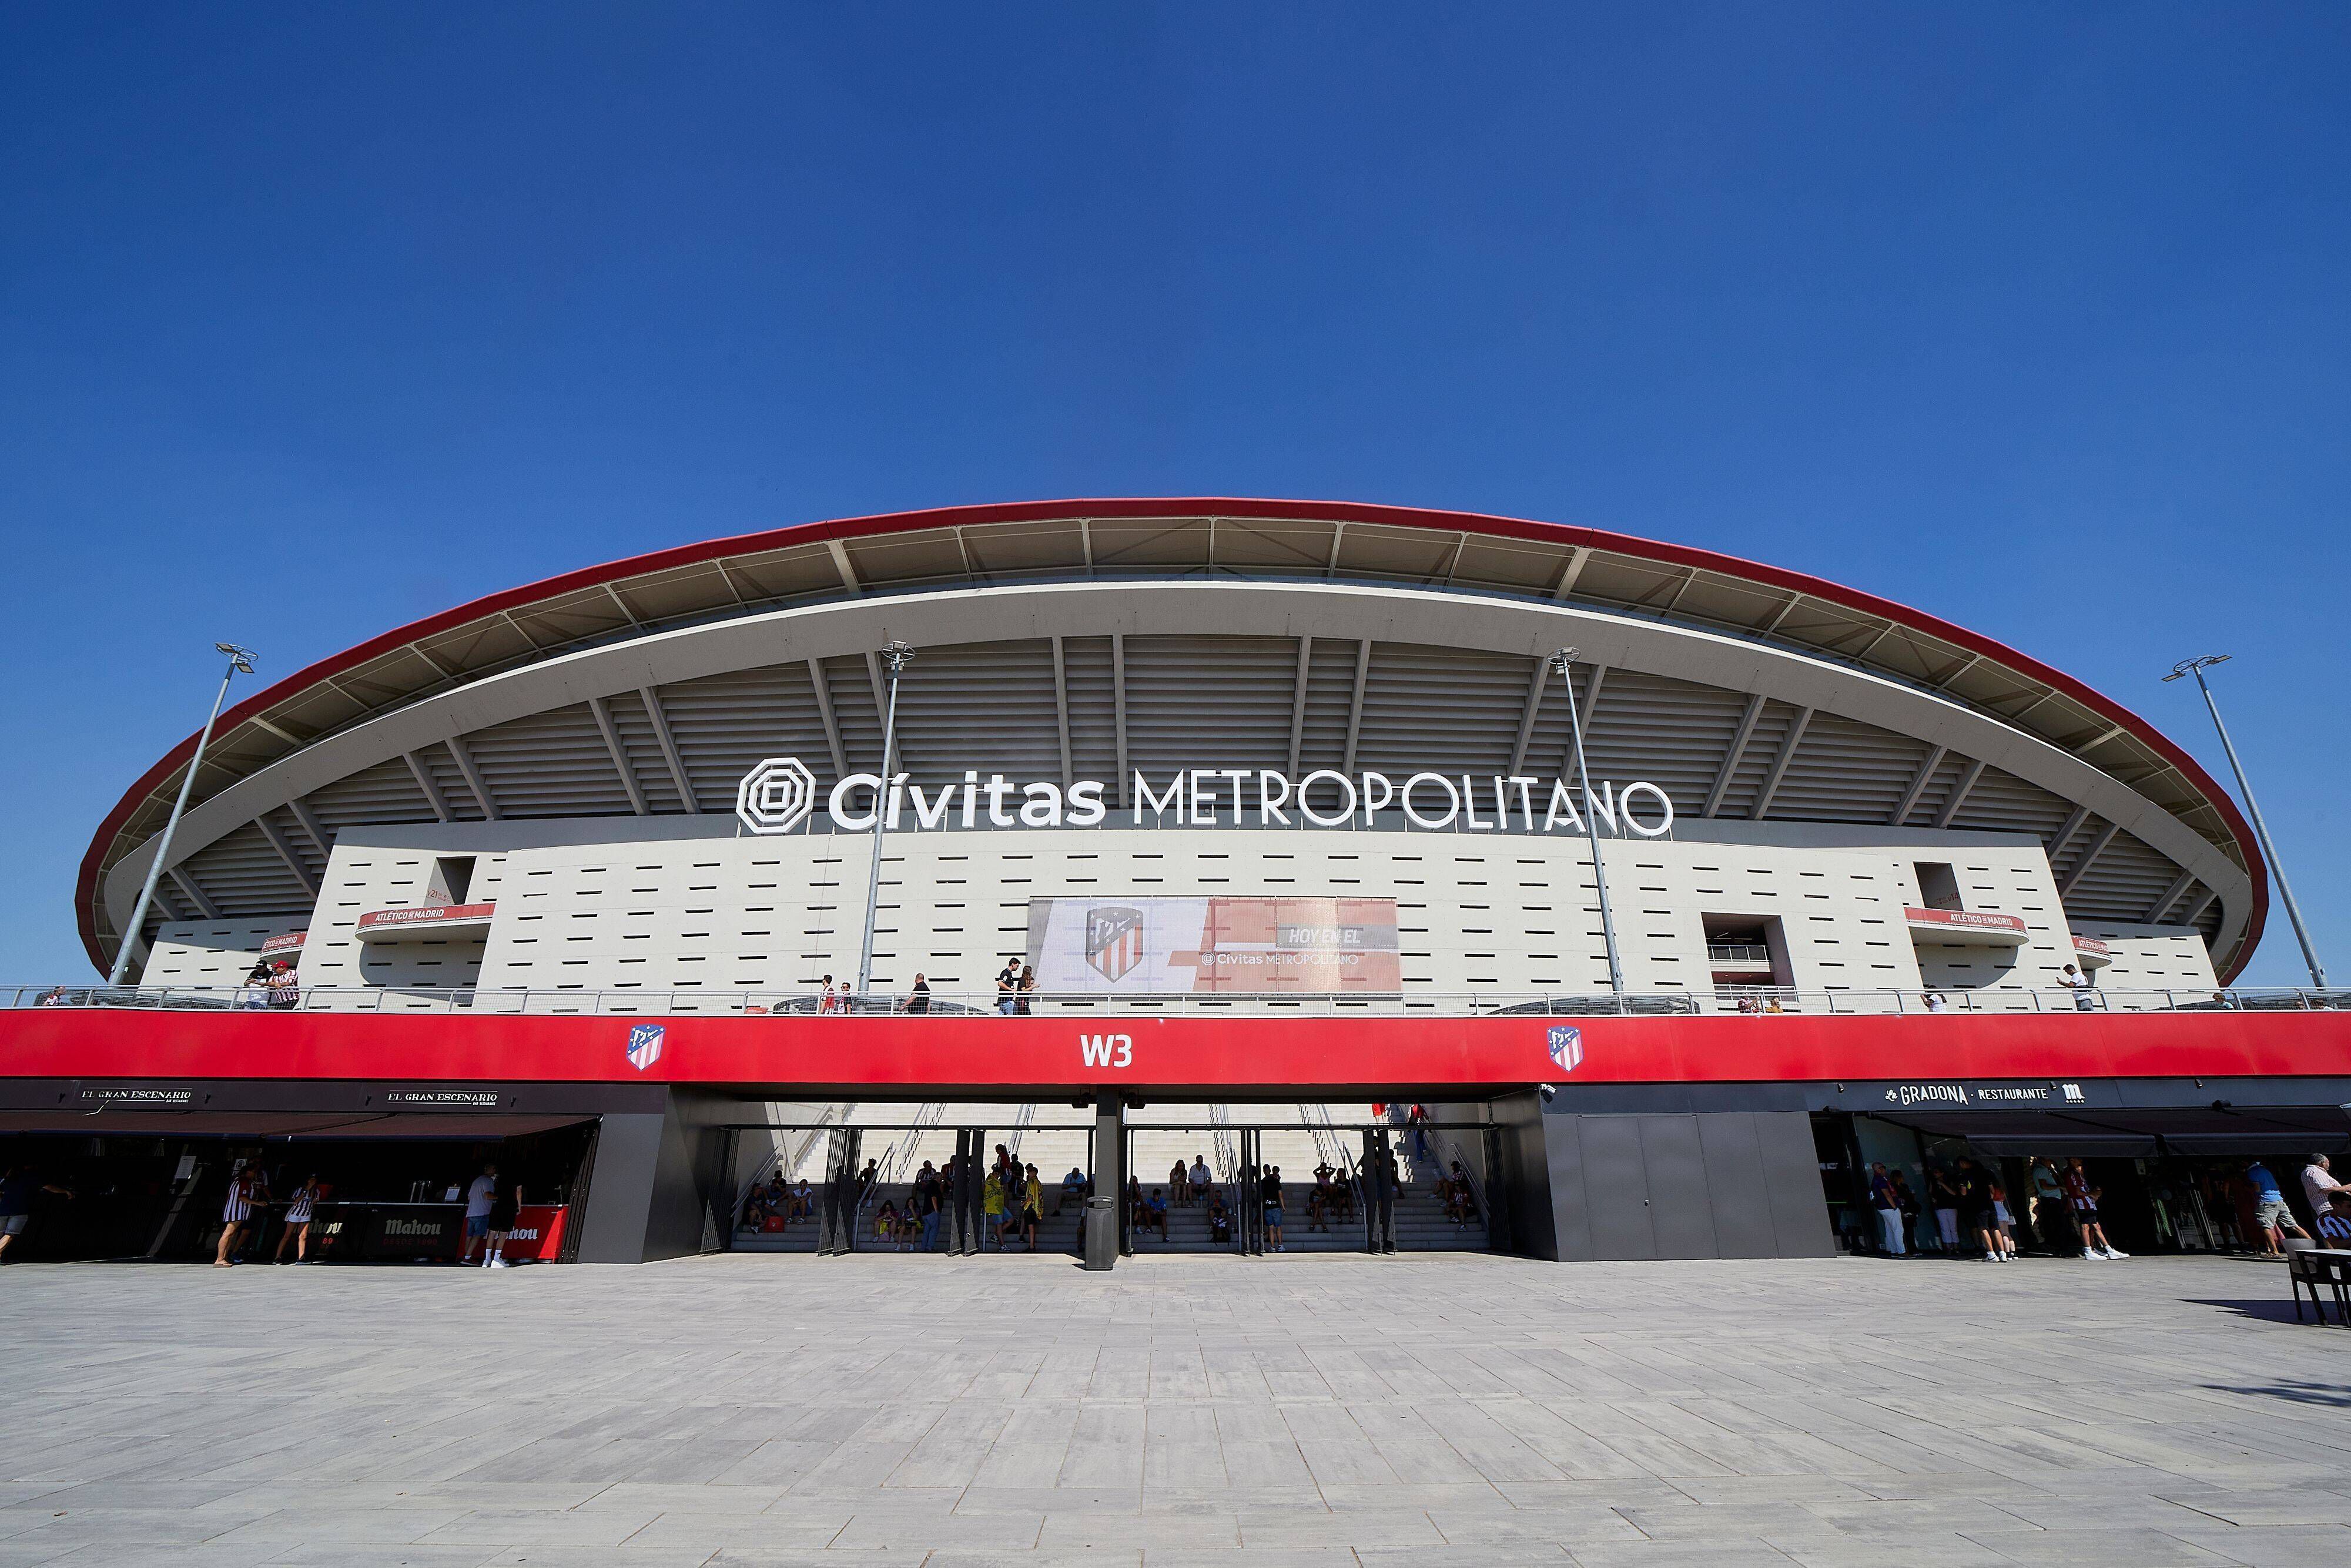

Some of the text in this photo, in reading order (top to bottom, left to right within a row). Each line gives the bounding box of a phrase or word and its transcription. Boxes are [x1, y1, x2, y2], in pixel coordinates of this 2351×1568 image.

[828, 768, 1674, 837] Cívitas METROPOLITANO
[375, 910, 408, 921] ATLÉTICO
[414, 909, 444, 919] MADRID
[1951, 913, 1982, 923] ATLÉTICO
[1987, 916, 2013, 926] MADRID
[264, 940, 276, 949] ÉTICO
[278, 936, 297, 946] MADRID
[1289, 929, 1361, 944] HOY EN EL
[1217, 953, 1359, 965] Cívitas METROPOLITANO
[1080, 1034, 1133, 1067] W3
[436, 1093, 497, 1101] ESCENARIO
[1900, 1085, 1969, 1105] GRADONA
[1977, 1088, 2049, 1100] RESTAURANTE
[384, 1219, 441, 1235] Mahou
